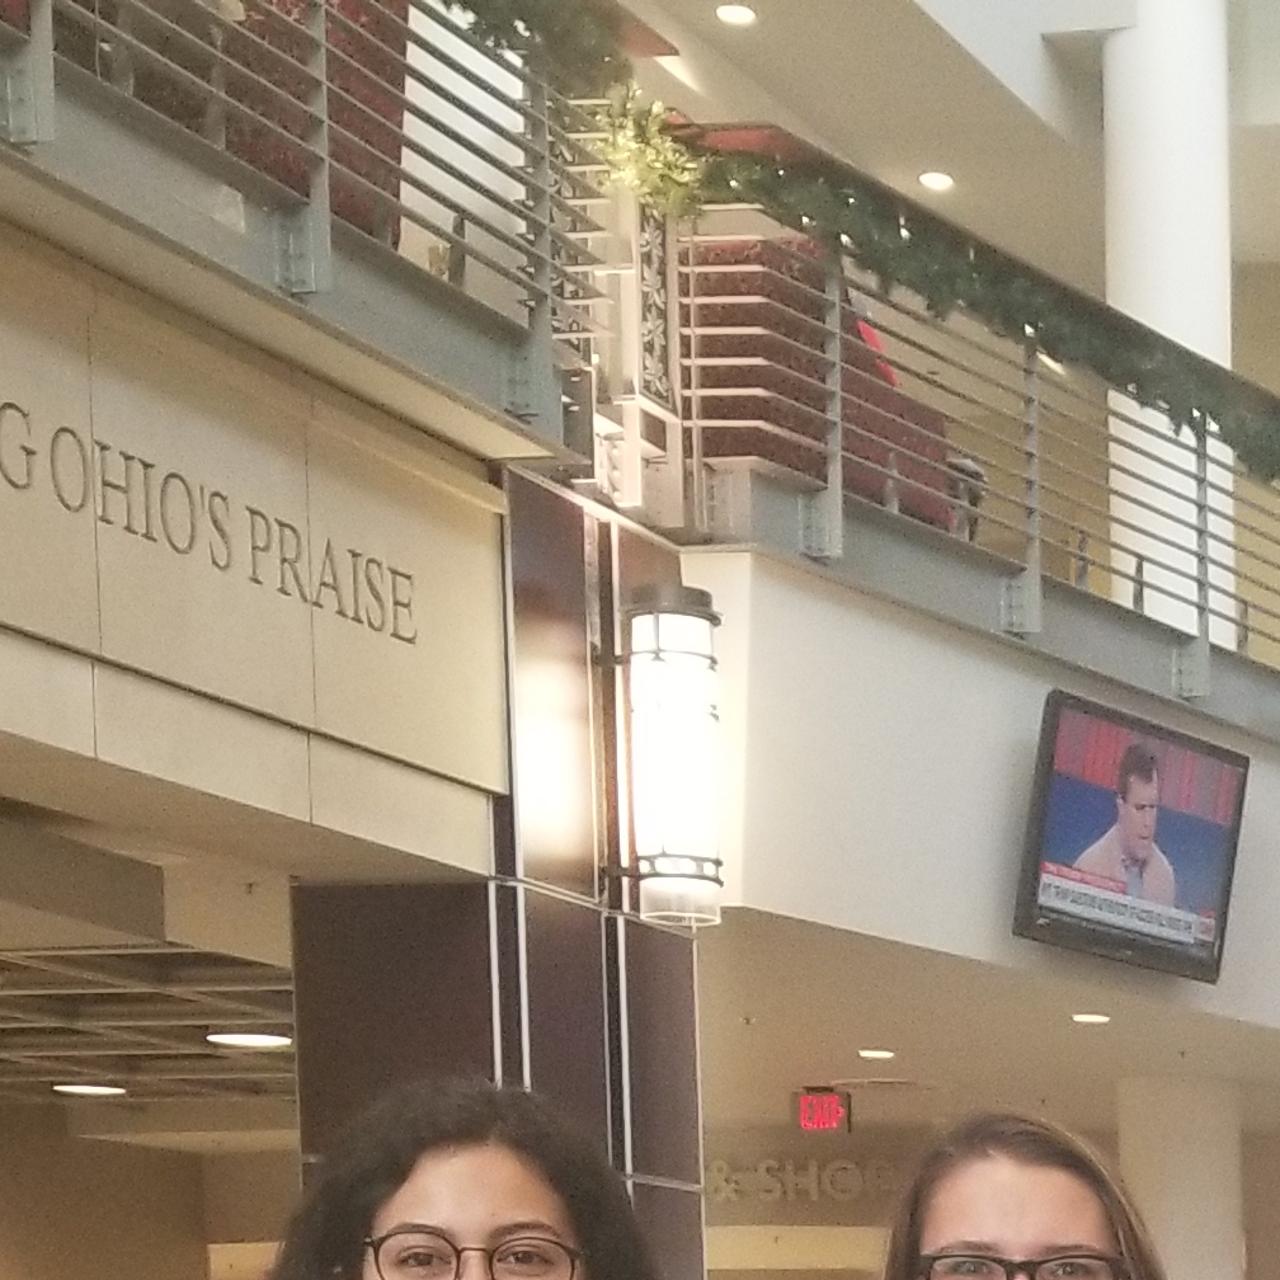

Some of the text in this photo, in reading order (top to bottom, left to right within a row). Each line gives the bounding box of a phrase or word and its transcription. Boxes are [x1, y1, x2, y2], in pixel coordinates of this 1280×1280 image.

[50, 425, 233, 571] OHIO'S
[244, 503, 418, 645] PRAISE
[800, 1094, 839, 1129] EXIT
